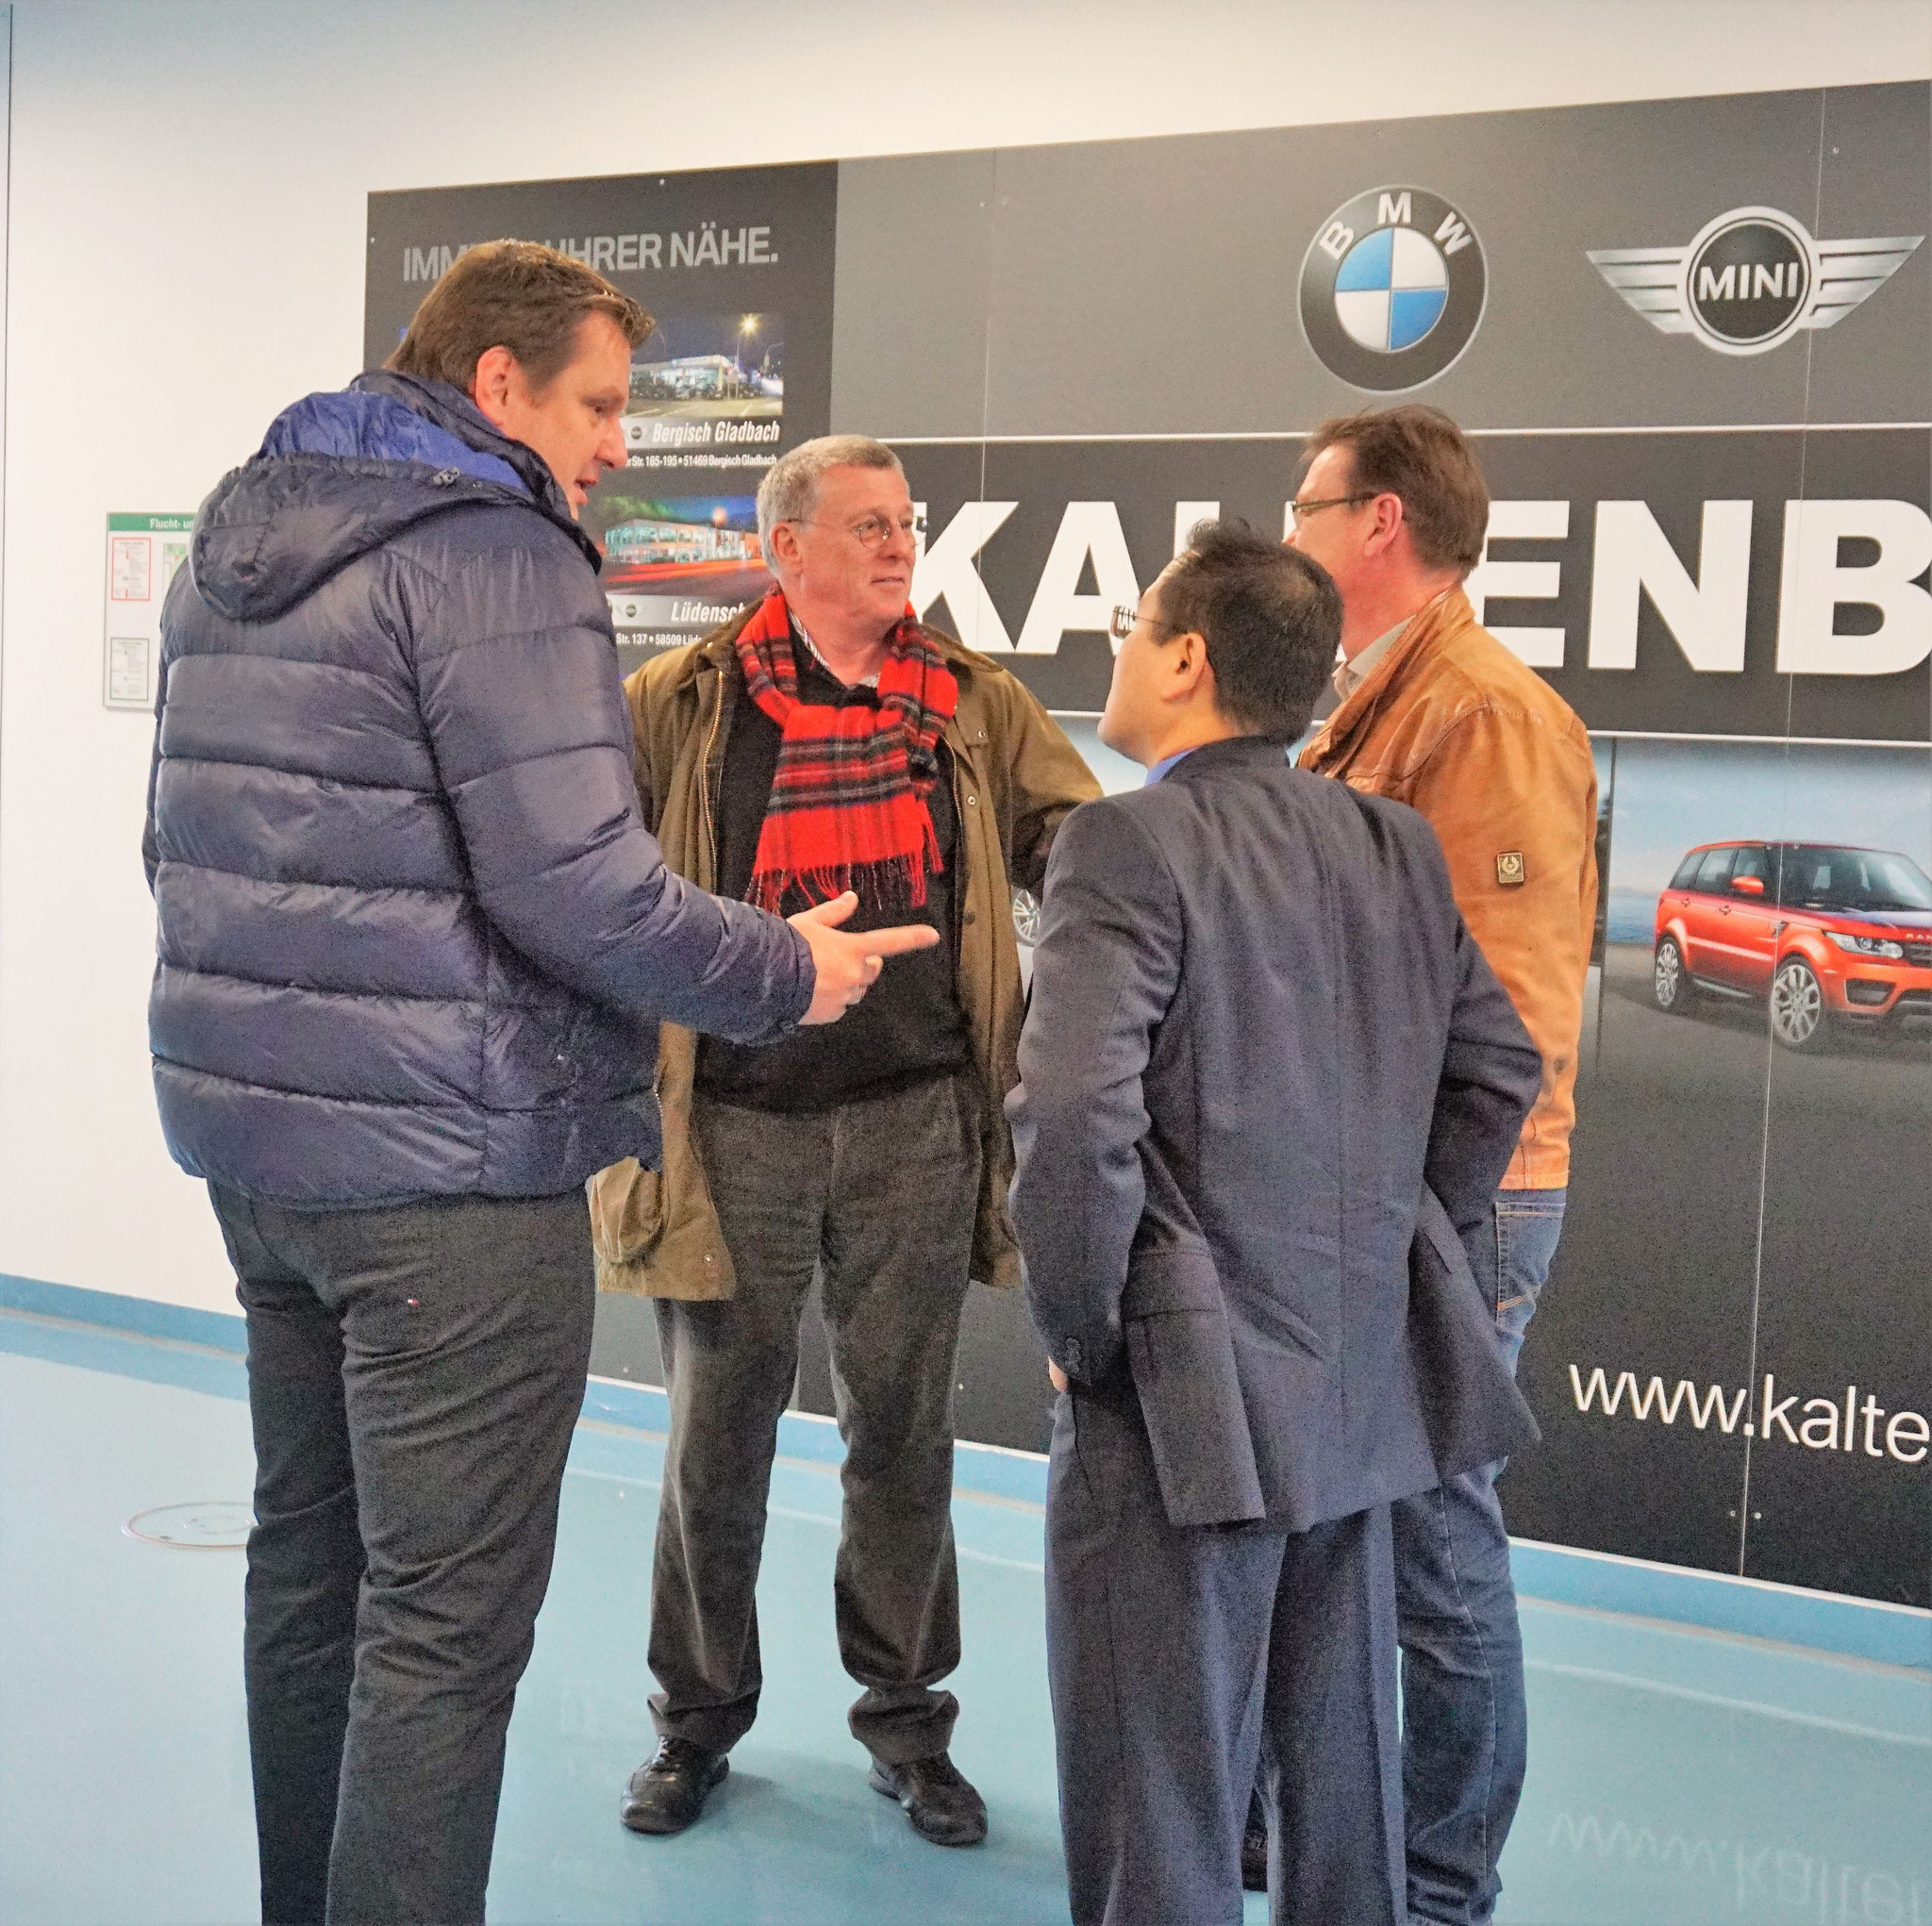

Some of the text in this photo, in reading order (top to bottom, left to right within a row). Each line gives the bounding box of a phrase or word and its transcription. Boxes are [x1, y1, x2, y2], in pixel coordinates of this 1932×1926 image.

[670, 221, 779, 268] NÄHE.
[1319, 191, 1473, 260] BMW
[1697, 261, 1800, 303] MINI
[652, 420, 781, 447] Bergisch Gladbach
[708, 454, 741, 469] Bergisch
[150, 518, 181, 528] Flucht-
[910, 501, 1932, 675] KAENB
[615, 632, 631, 645] Str.
[632, 633, 648, 645] 137
[655, 633, 682, 646] 58509
[1568, 1363, 1932, 1463] www.kalte
